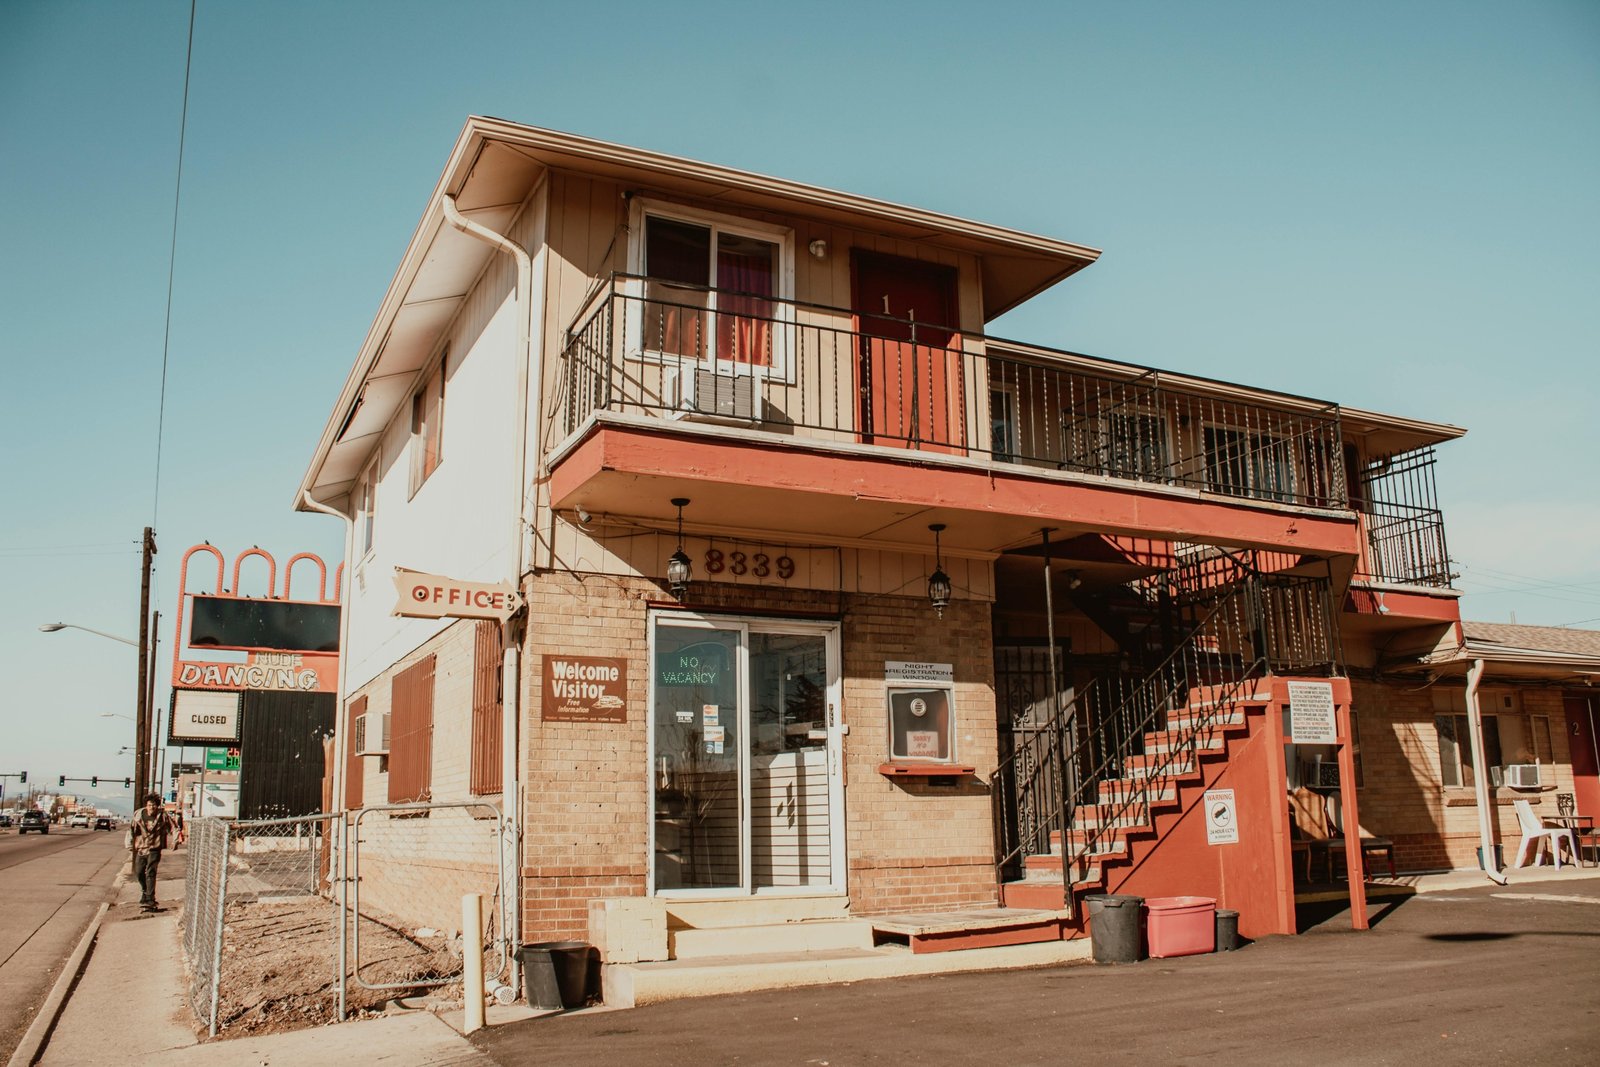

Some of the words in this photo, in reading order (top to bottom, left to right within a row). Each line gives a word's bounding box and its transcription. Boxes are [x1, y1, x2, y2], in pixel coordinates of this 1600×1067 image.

[704, 549, 795, 579] 8339
[412, 585, 504, 609] OFFICE
[255, 652, 304, 667] NUDE
[680, 657, 699, 668] NO
[180, 664, 318, 690] DANCING
[552, 661, 619, 681] Welcome
[662, 672, 716, 684] VACANCY
[552, 680, 606, 699] Visitor
[557, 705, 590, 714] Information
[566, 698, 581, 706] Free
[191, 714, 227, 725] CLOSED
[1572, 721, 1580, 736] 2
